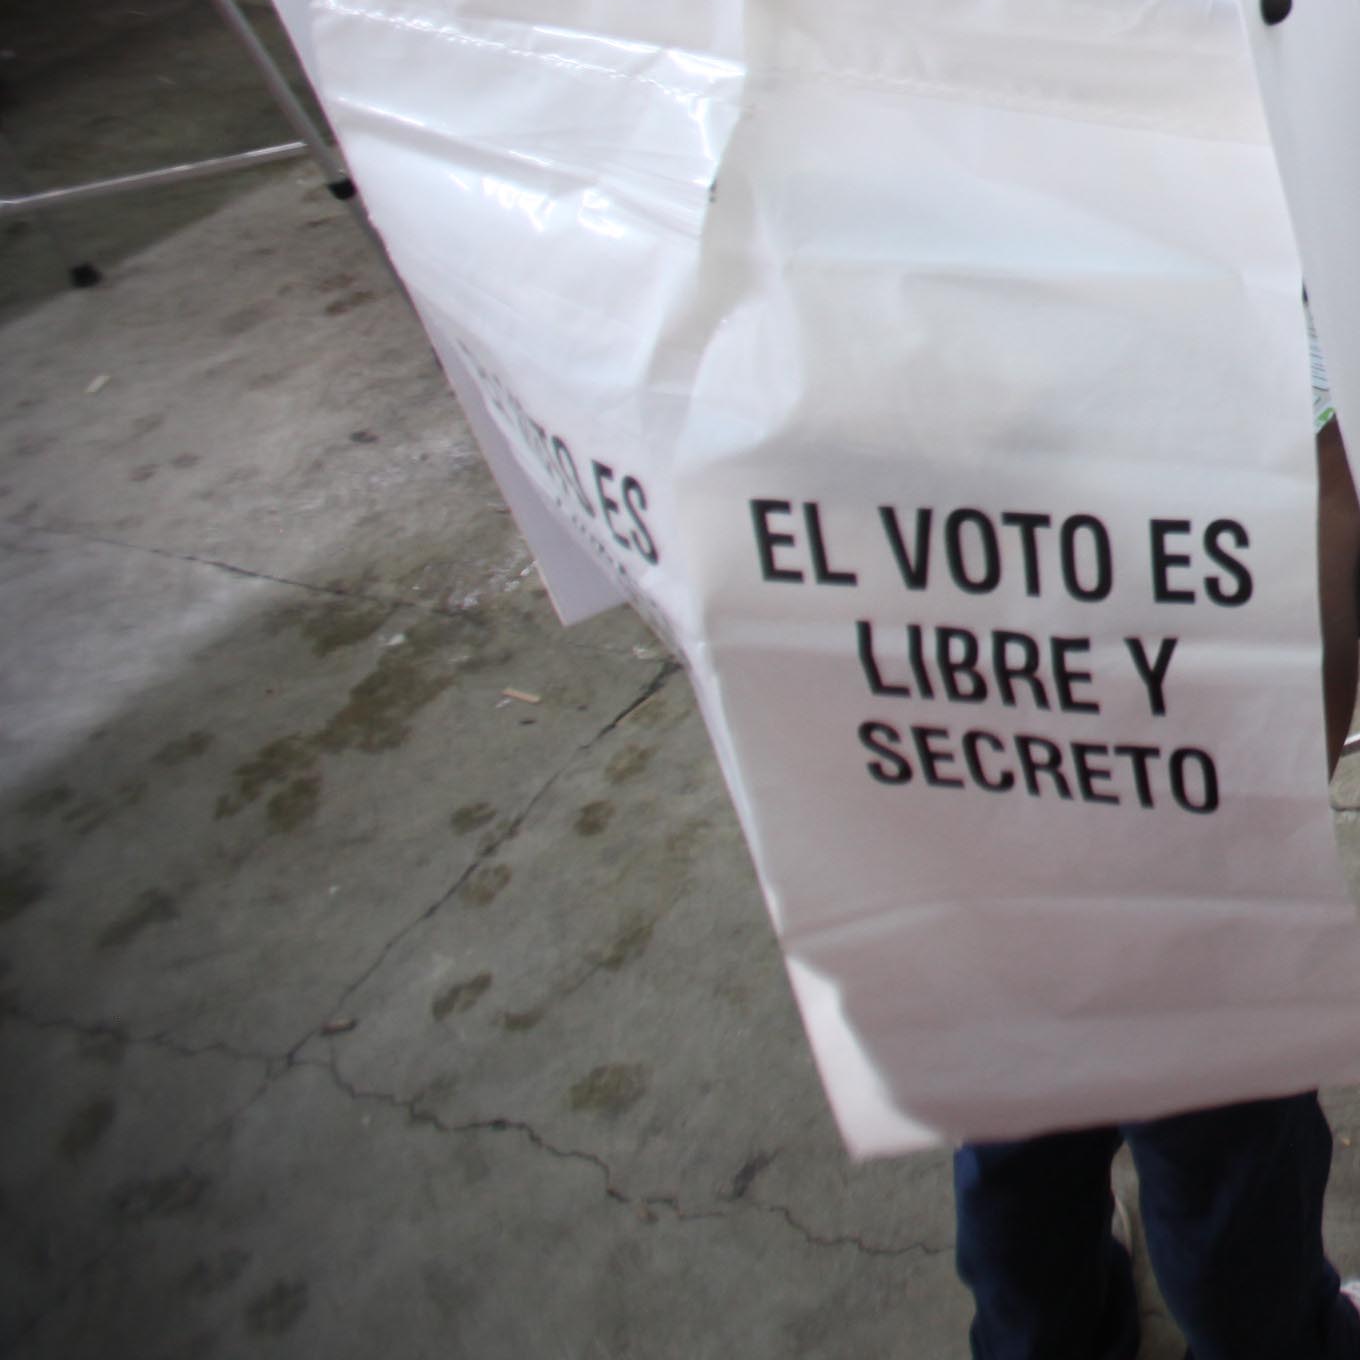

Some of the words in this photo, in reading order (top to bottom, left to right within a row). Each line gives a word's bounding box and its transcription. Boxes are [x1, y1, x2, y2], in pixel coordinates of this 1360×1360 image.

[591, 457, 660, 567] ES
[749, 498, 857, 586] EL
[877, 504, 1116, 603] VOTO
[1149, 517, 1255, 607] ES
[855, 620, 1101, 716] LIBRE
[1124, 636, 1179, 718] Y
[856, 721, 1221, 816] SECRETO
